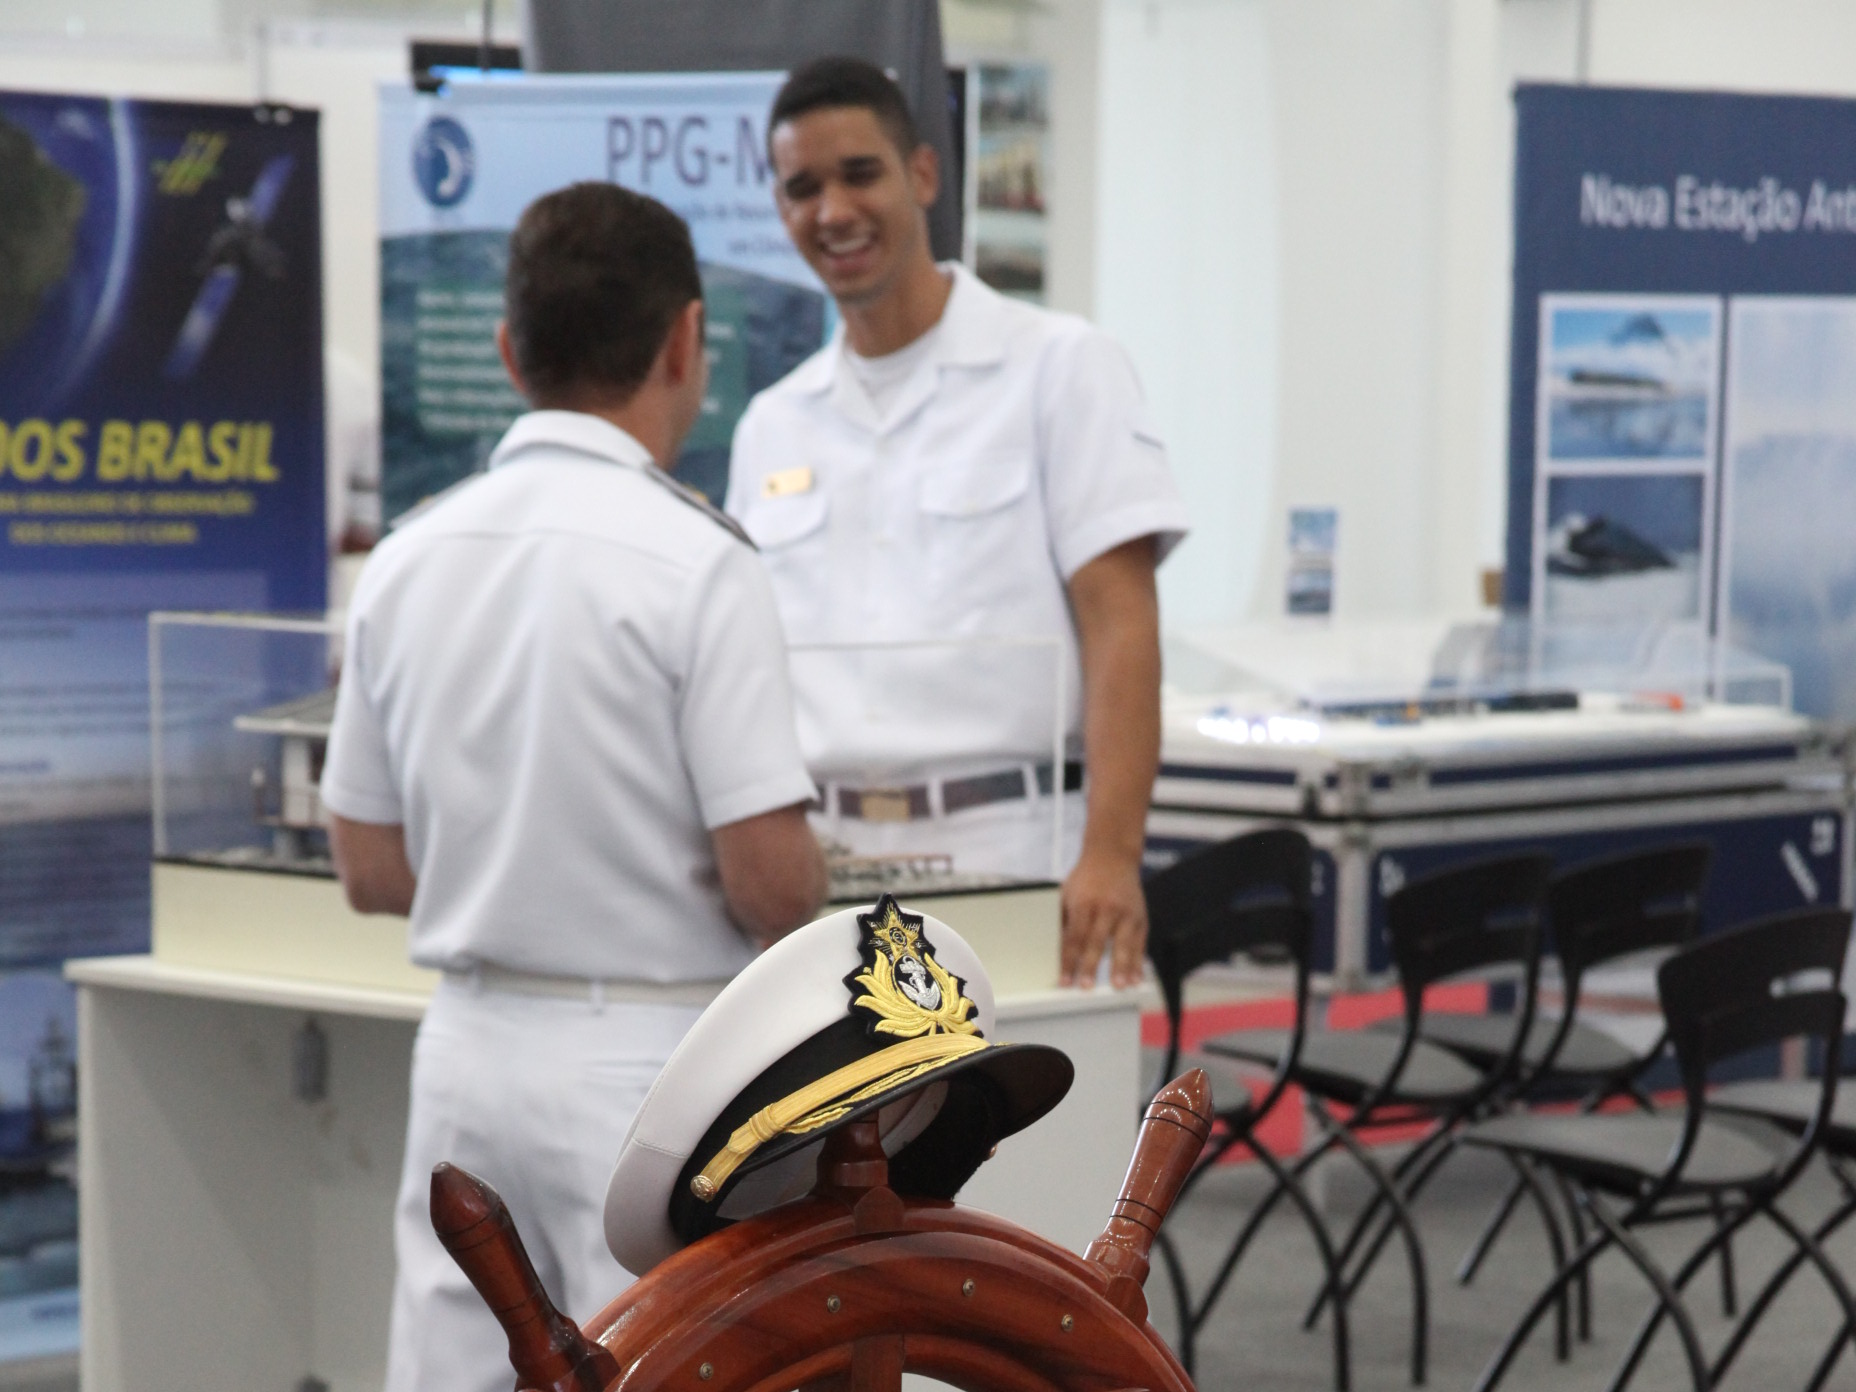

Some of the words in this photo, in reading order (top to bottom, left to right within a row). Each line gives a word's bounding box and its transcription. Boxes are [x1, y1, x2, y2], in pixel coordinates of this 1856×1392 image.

[1580, 173, 1668, 229] Nova
[1675, 174, 1801, 242] Estação
[0, 418, 87, 481] OS
[98, 420, 279, 482] BRASIL
